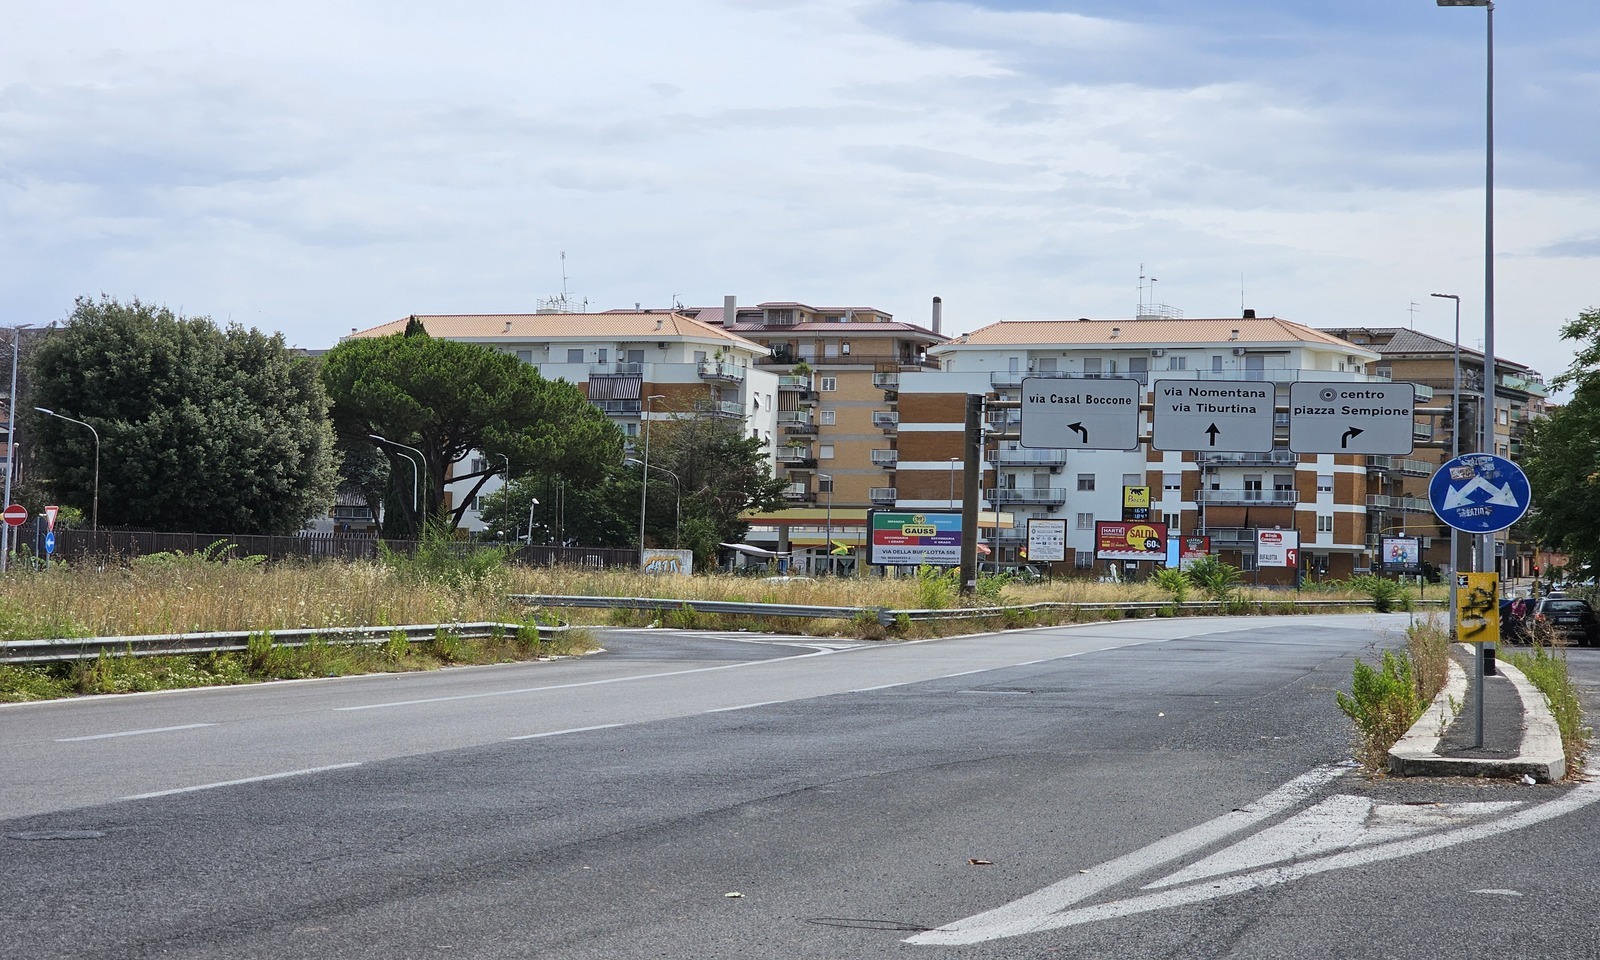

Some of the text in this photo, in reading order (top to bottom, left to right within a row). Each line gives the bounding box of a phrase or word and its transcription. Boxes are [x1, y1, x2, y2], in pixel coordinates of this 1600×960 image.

[1164, 387, 1266, 398] via Nomentana
[1340, 390, 1385, 399] centro
[1029, 393, 1132, 405] via Casal Boccone
[1172, 403, 1257, 414] via Tiburtina
[1294, 405, 1409, 417] piazza Sempione
[1130, 529, 1154, 538] SALDI
